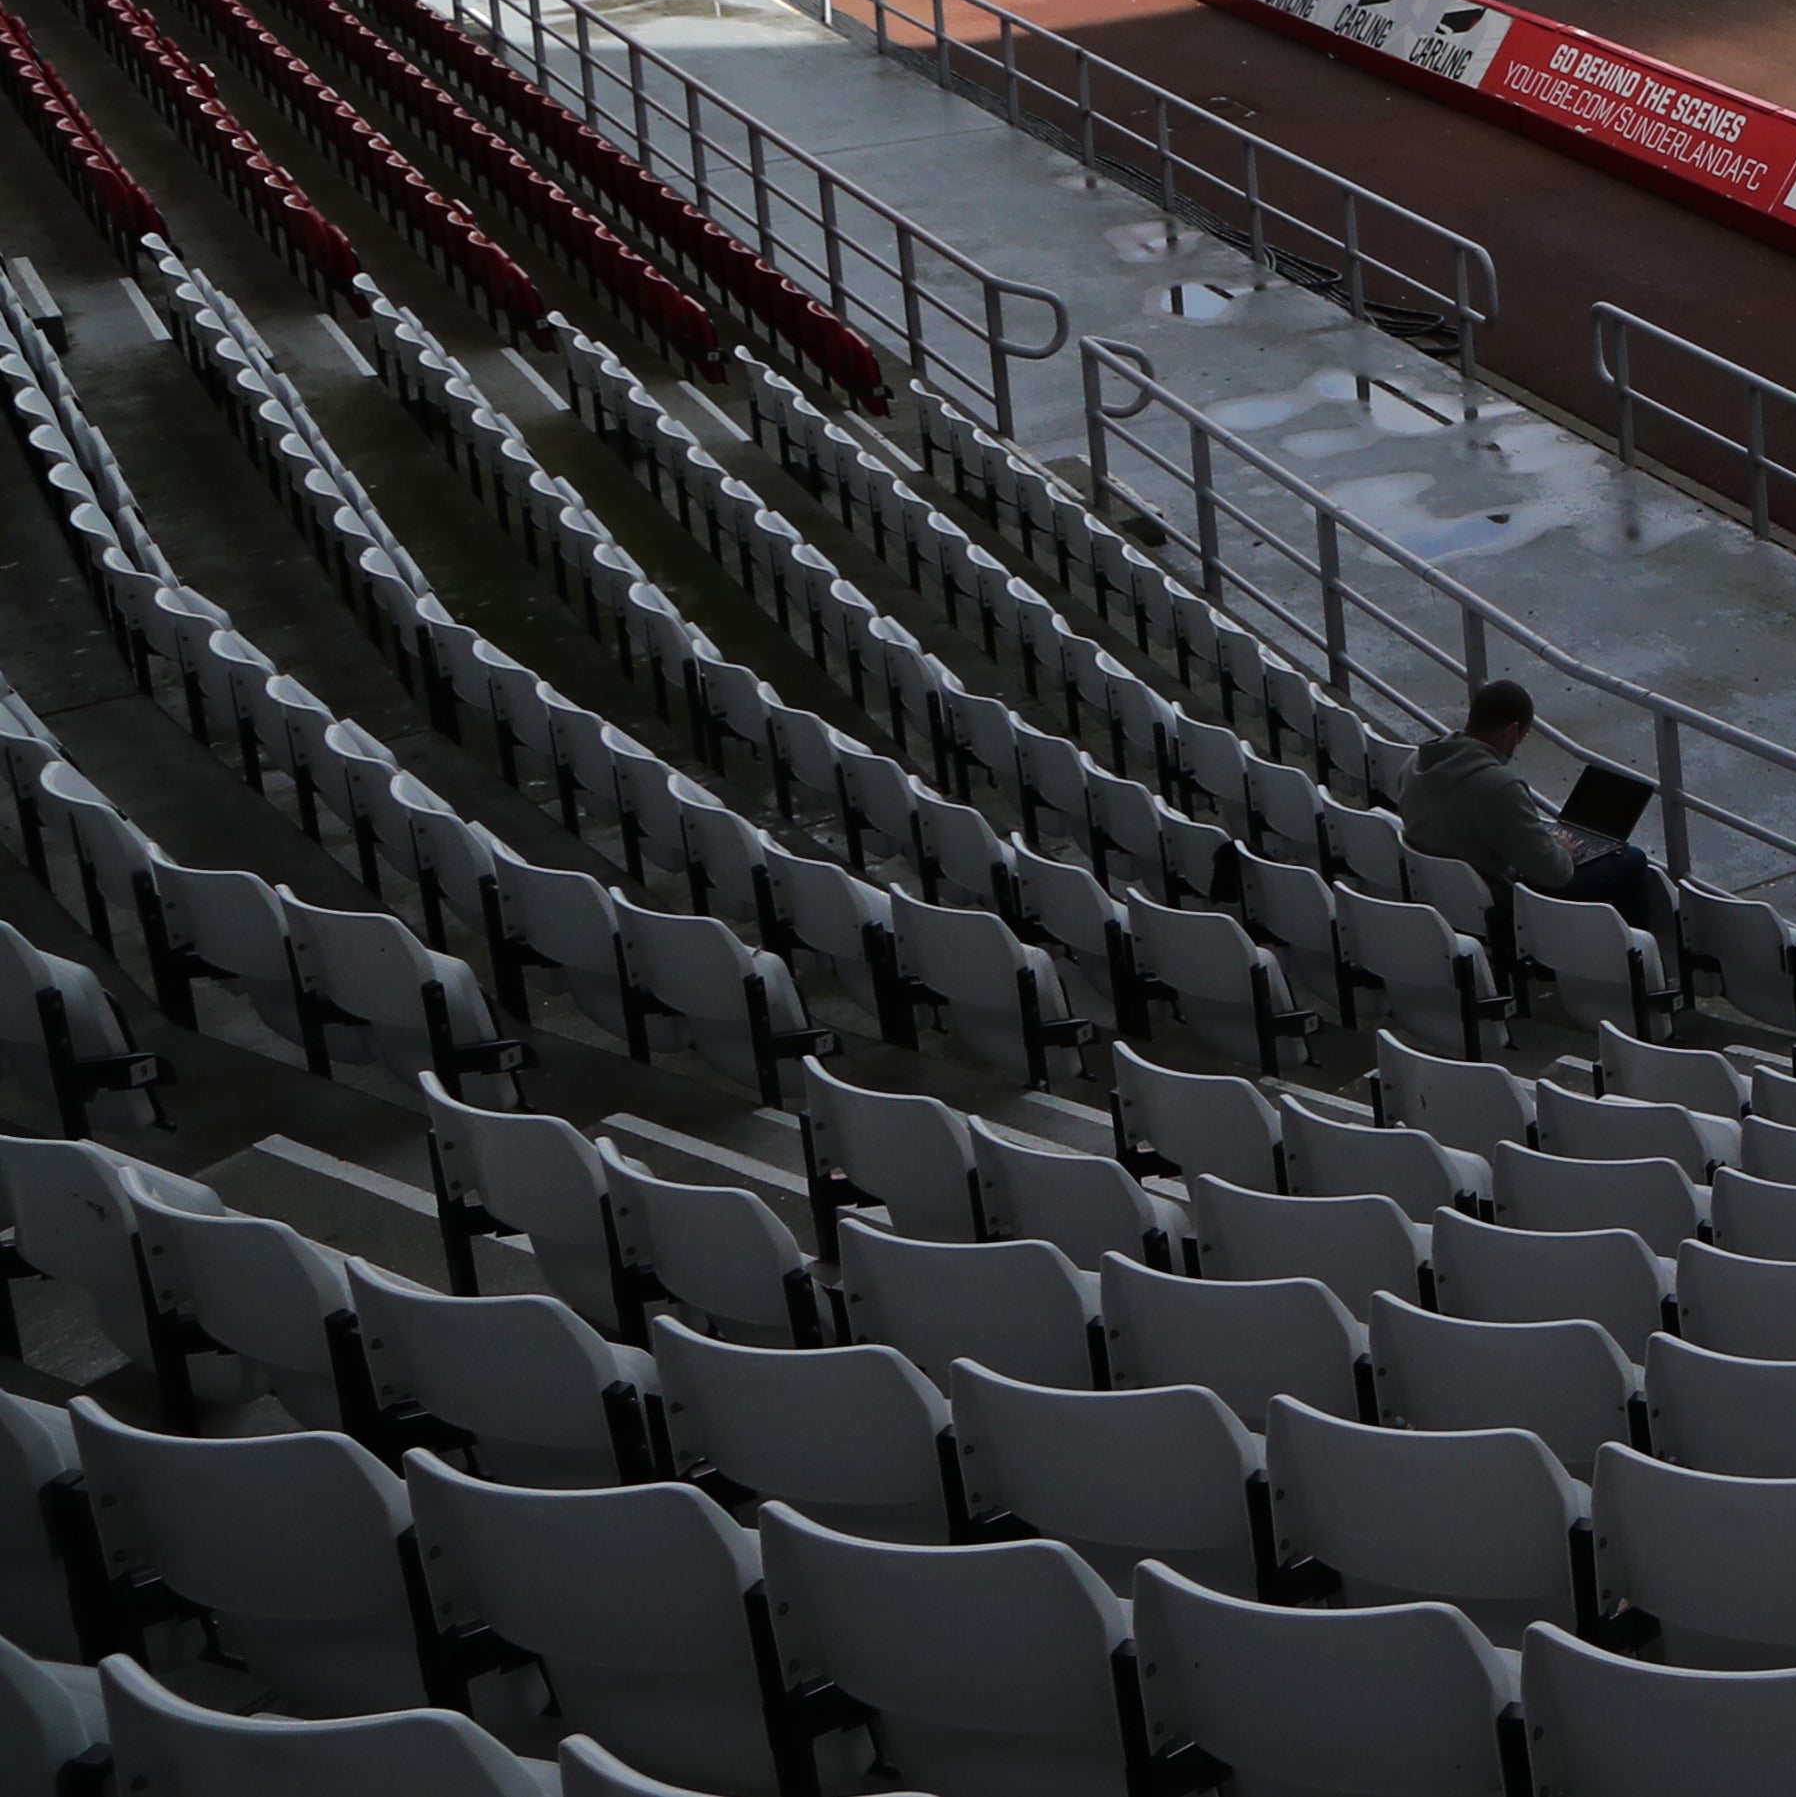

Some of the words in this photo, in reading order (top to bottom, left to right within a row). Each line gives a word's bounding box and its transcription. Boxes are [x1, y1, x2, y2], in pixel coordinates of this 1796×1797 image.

[1334, 3, 1391, 50] CARLING
[1409, 34, 1470, 81] CARLING
[1501, 59, 1768, 192] YOUTUBE.COM/SUNDERLANDAFC
[1549, 44, 1578, 73] GO
[1573, 55, 1640, 100] BEHIND
[1636, 76, 1673, 113] THE
[1668, 90, 1746, 143] SCENES
